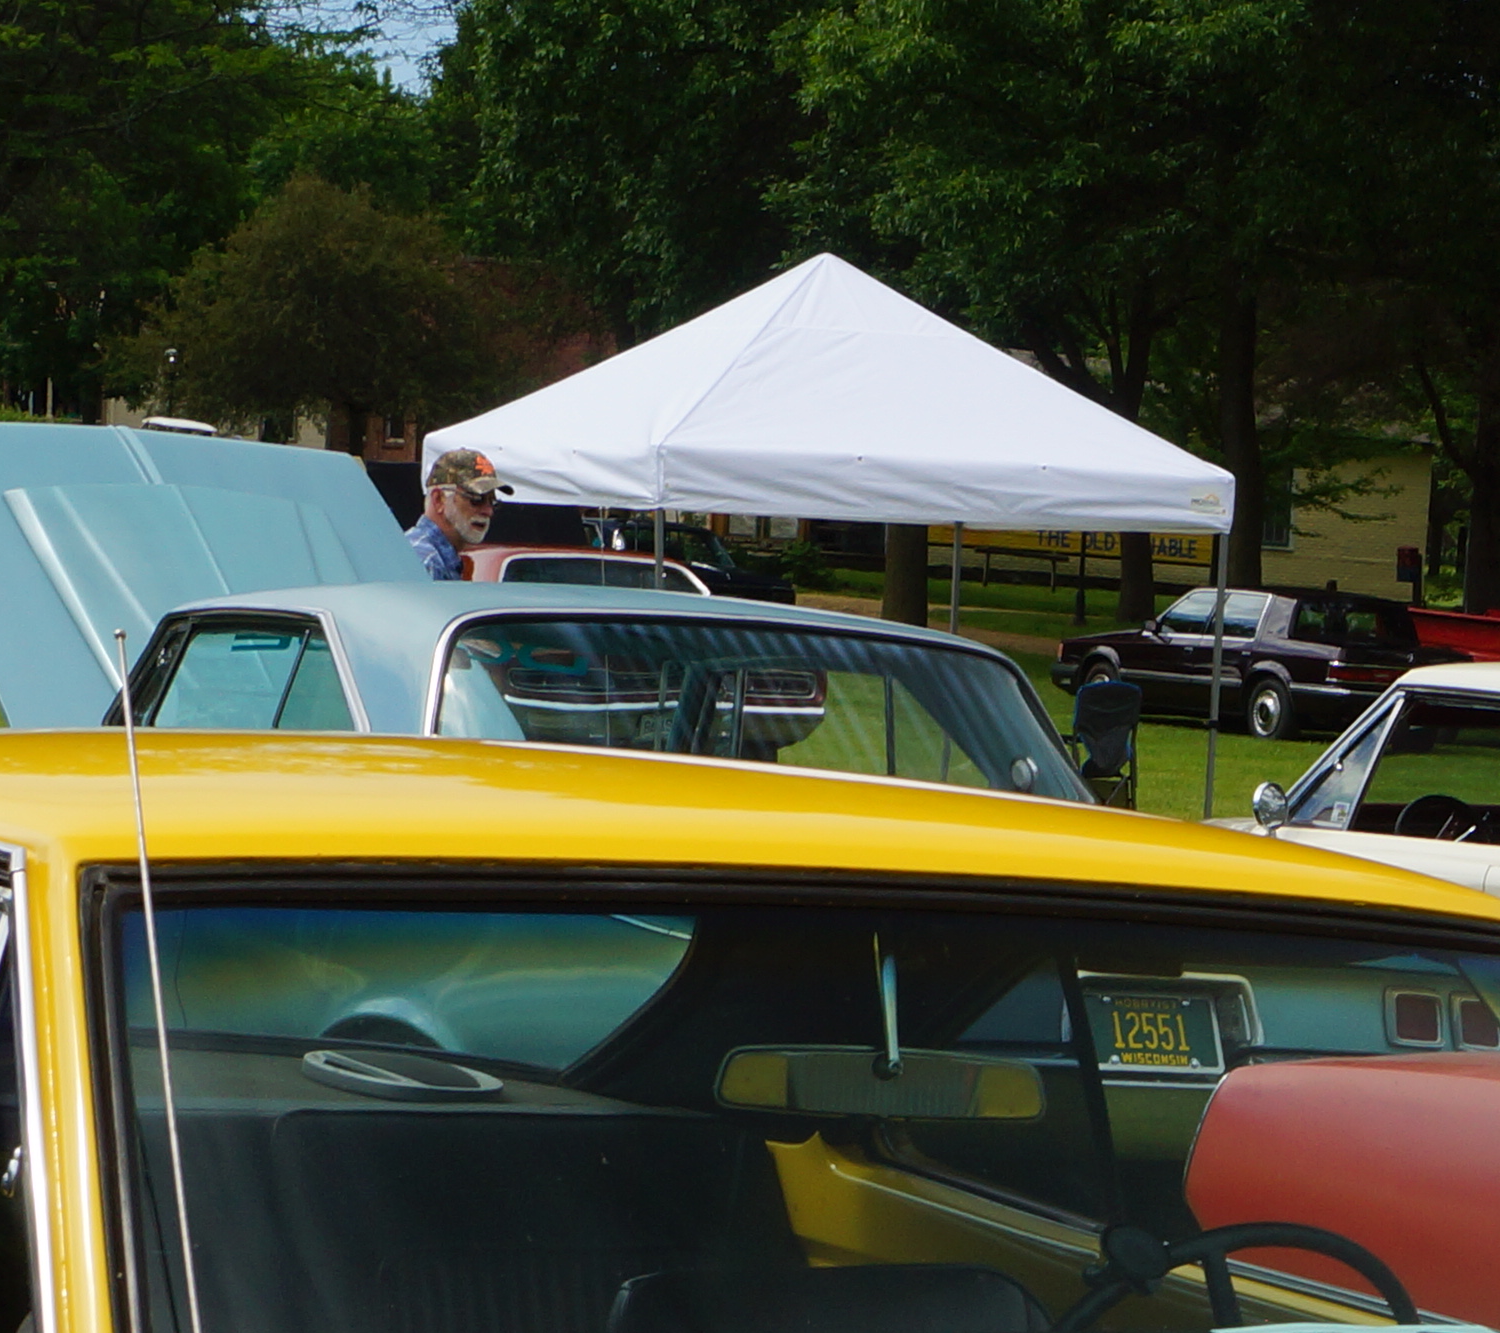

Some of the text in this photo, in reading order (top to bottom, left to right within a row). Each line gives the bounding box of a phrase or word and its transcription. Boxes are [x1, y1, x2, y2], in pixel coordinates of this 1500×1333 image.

[1037, 530, 1071, 548] THE
[1112, 1011, 1191, 1052] 12551
[1120, 1052, 1189, 1066] WISCONSIN
